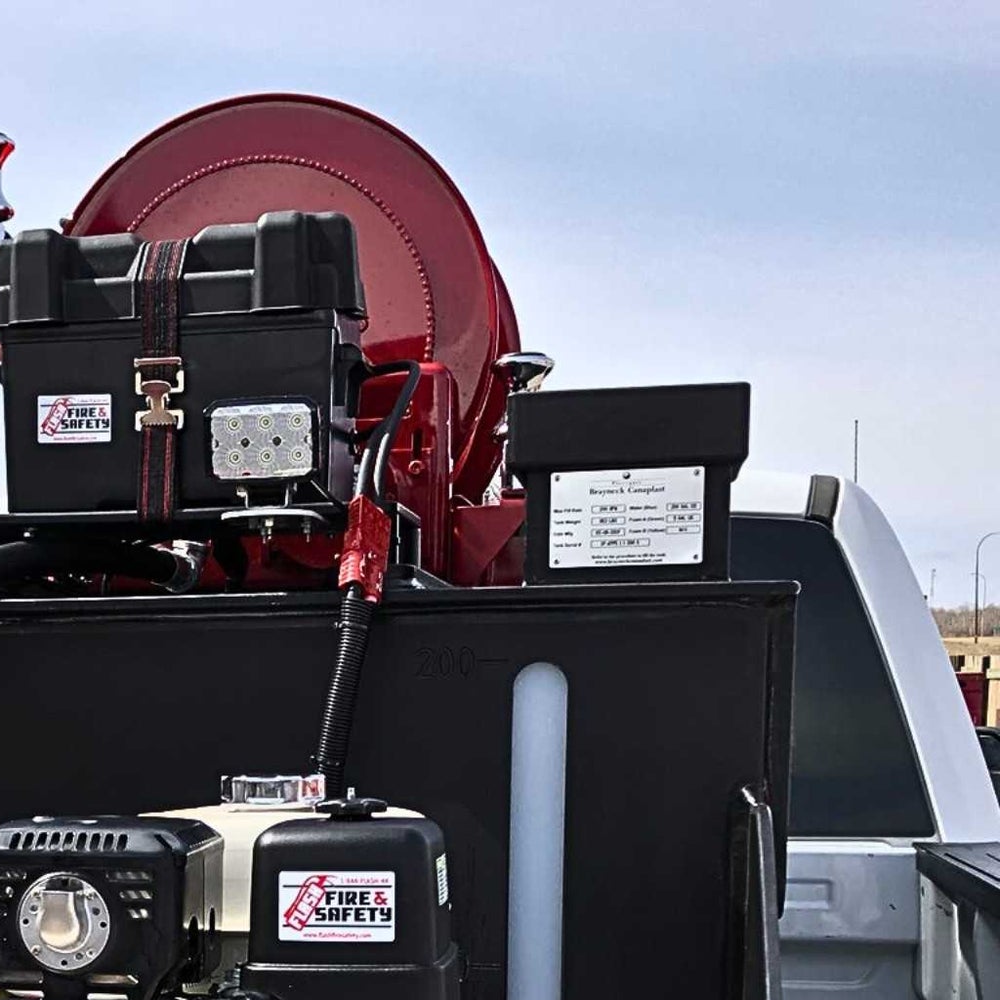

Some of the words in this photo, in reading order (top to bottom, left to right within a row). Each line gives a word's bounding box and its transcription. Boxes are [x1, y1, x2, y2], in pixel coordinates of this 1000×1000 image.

[67, 407, 97, 418] FIRE
[98, 407, 106, 417] &
[61, 418, 110, 429] SAFETY
[325, 891, 371, 905] FIRE
[374, 892, 388, 905] &
[314, 907, 392, 922] SAFETY
